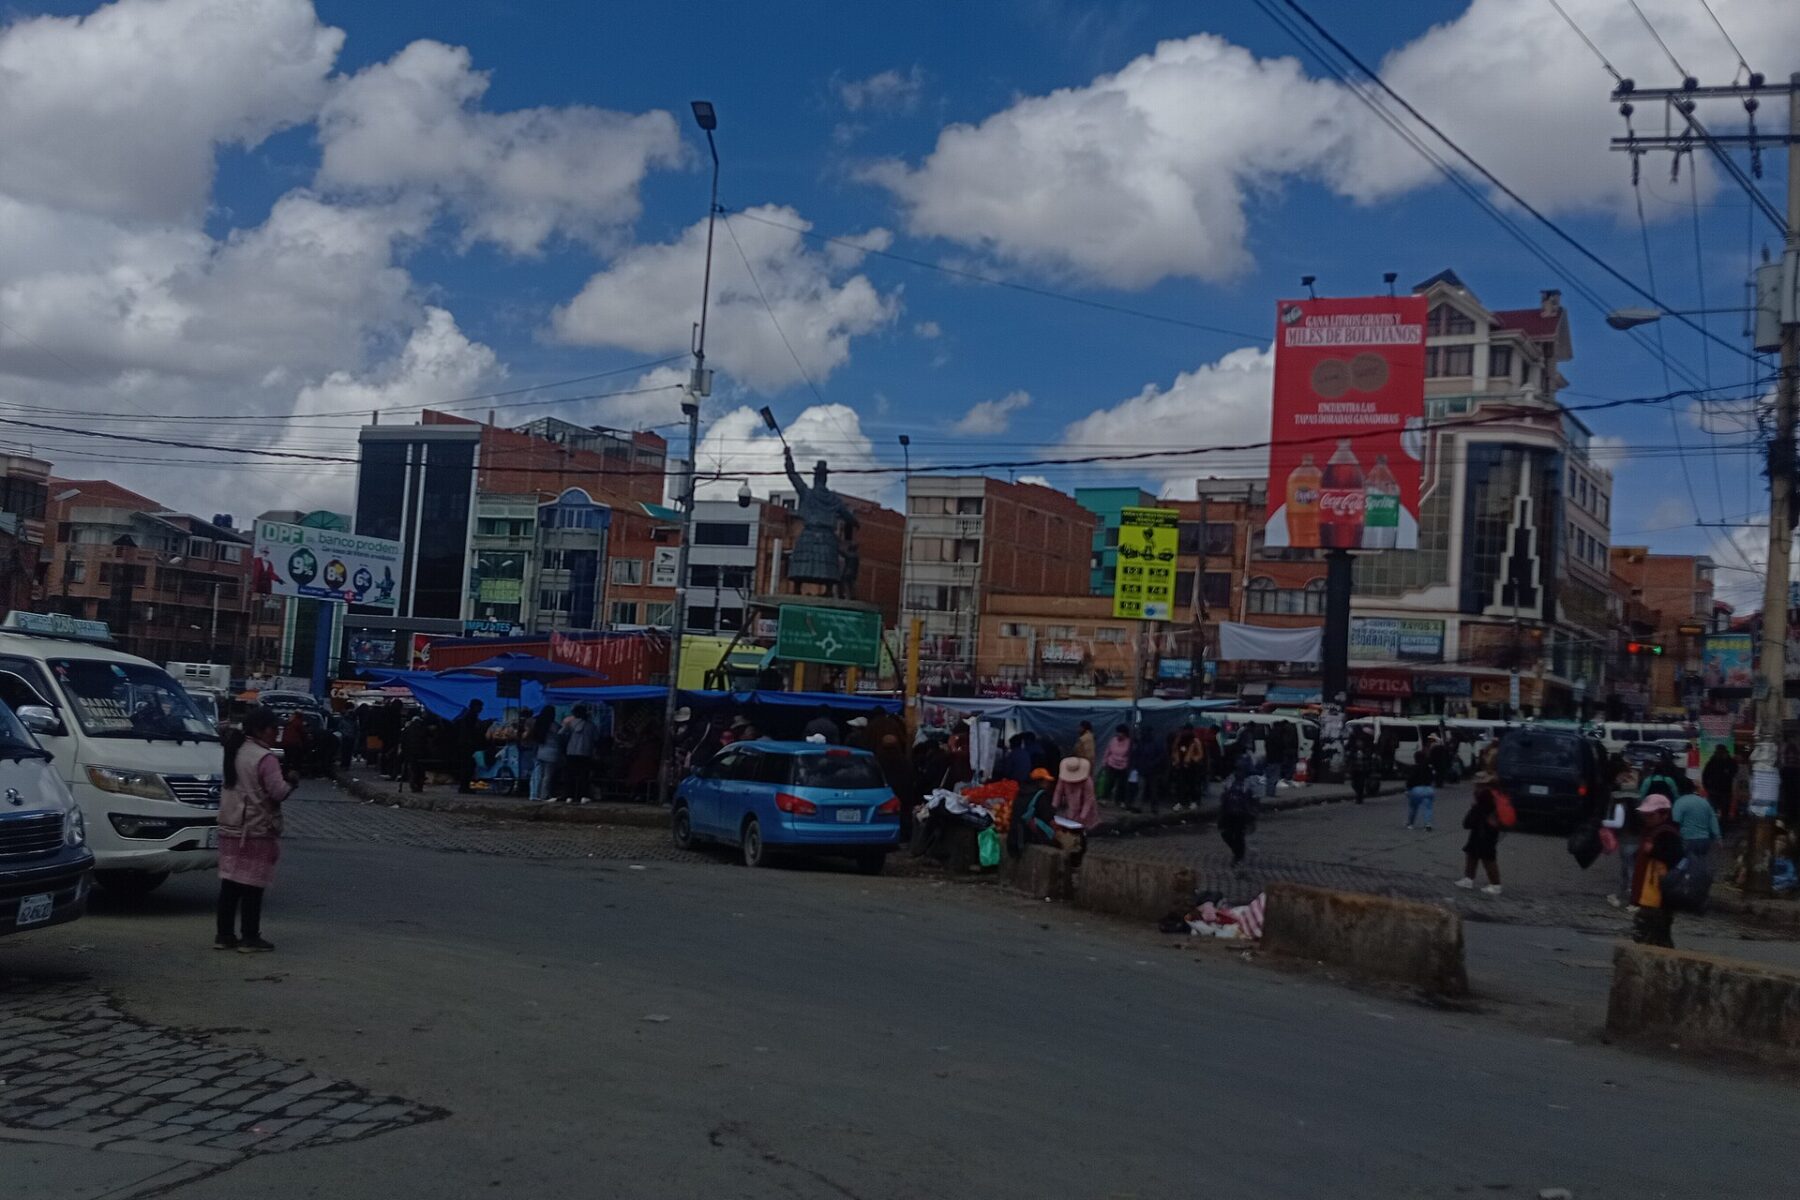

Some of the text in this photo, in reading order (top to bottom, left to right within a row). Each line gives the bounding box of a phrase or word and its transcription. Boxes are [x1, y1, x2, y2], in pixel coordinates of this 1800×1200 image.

[1287, 325, 1419, 345] MILES DE BOLIVIANOS
[263, 523, 399, 555] DPF banco prodem
